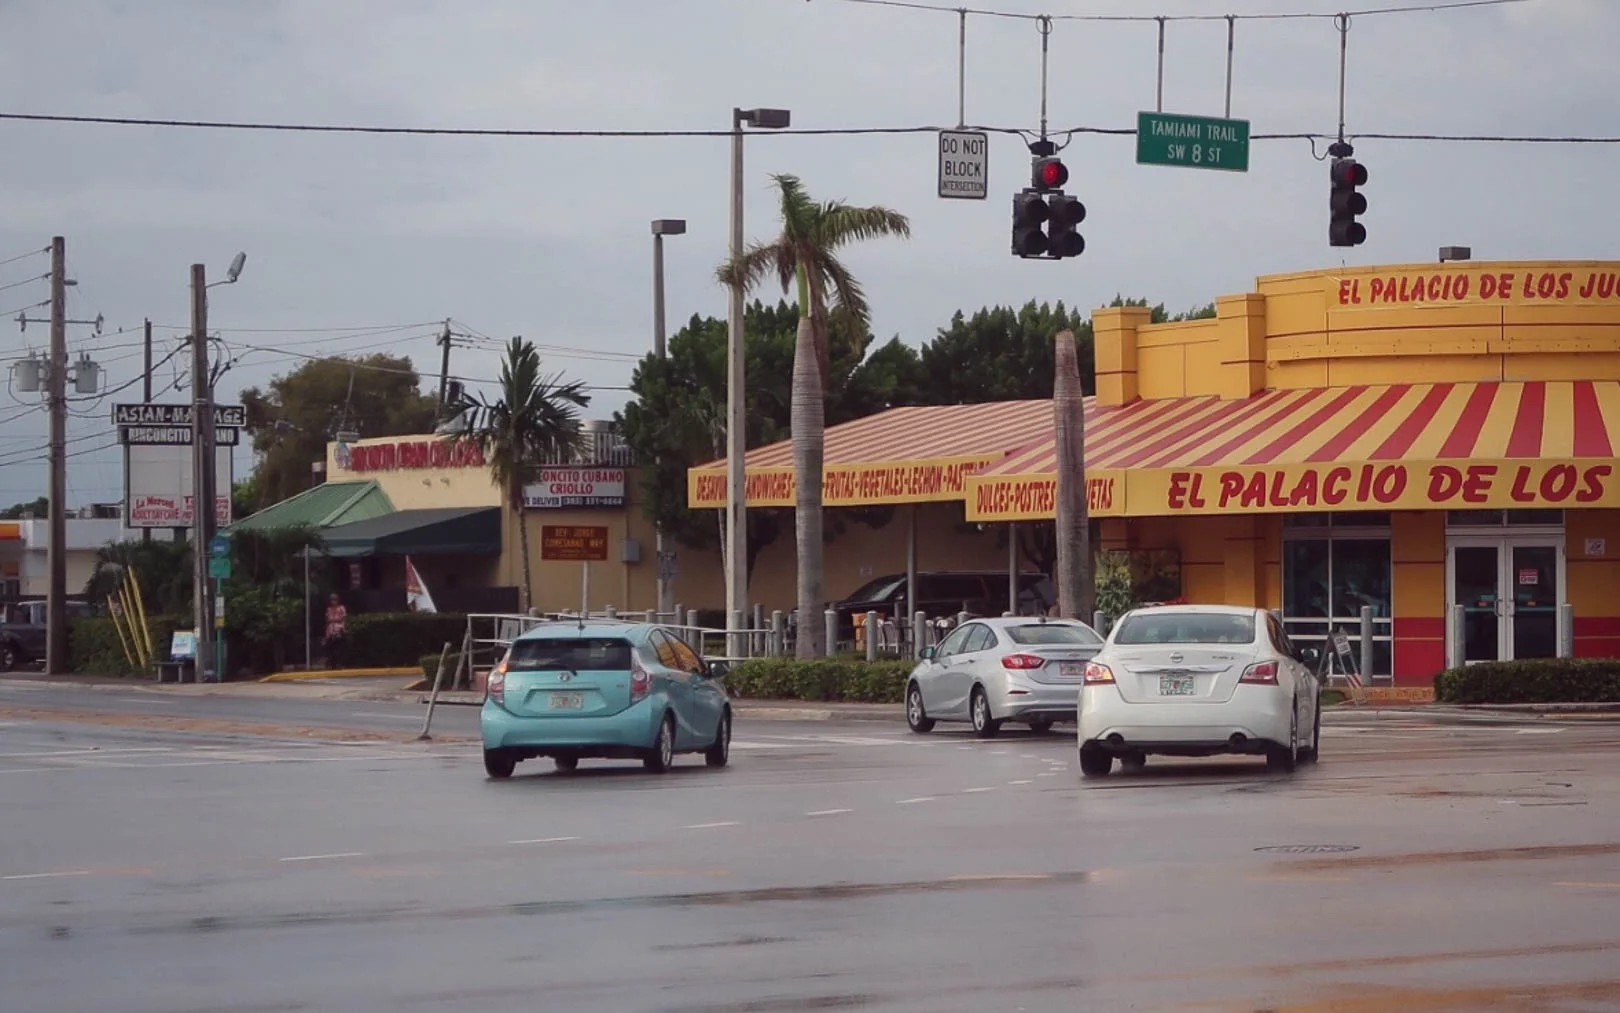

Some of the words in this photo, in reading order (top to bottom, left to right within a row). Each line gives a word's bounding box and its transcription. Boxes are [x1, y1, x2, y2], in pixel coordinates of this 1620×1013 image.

[1151, 120, 1201, 138] TAMIAMI
[1207, 125, 1237, 142] TRAIL
[942, 138, 958, 153] DO
[962, 139, 984, 155] NOT
[1167, 143, 1186, 160] SW
[1192, 143, 1202, 163] 8
[1208, 147, 1221, 163] ST
[944, 160, 982, 177] BLOCK
[1339, 279, 1361, 304] EL
[1370, 274, 1469, 303] PALACIO
[1480, 273, 1515, 299] DE
[1523, 272, 1573, 299] LOS
[1580, 273, 1620, 299] JU
[582, 471, 623, 482] CUBANO
[550, 483, 593, 495] CRIOLLO
[1168, 473, 1205, 509] EL
[1218, 464, 1408, 508] PALACIO
[1427, 465, 1498, 503] DE
[1510, 463, 1612, 502] LOS
